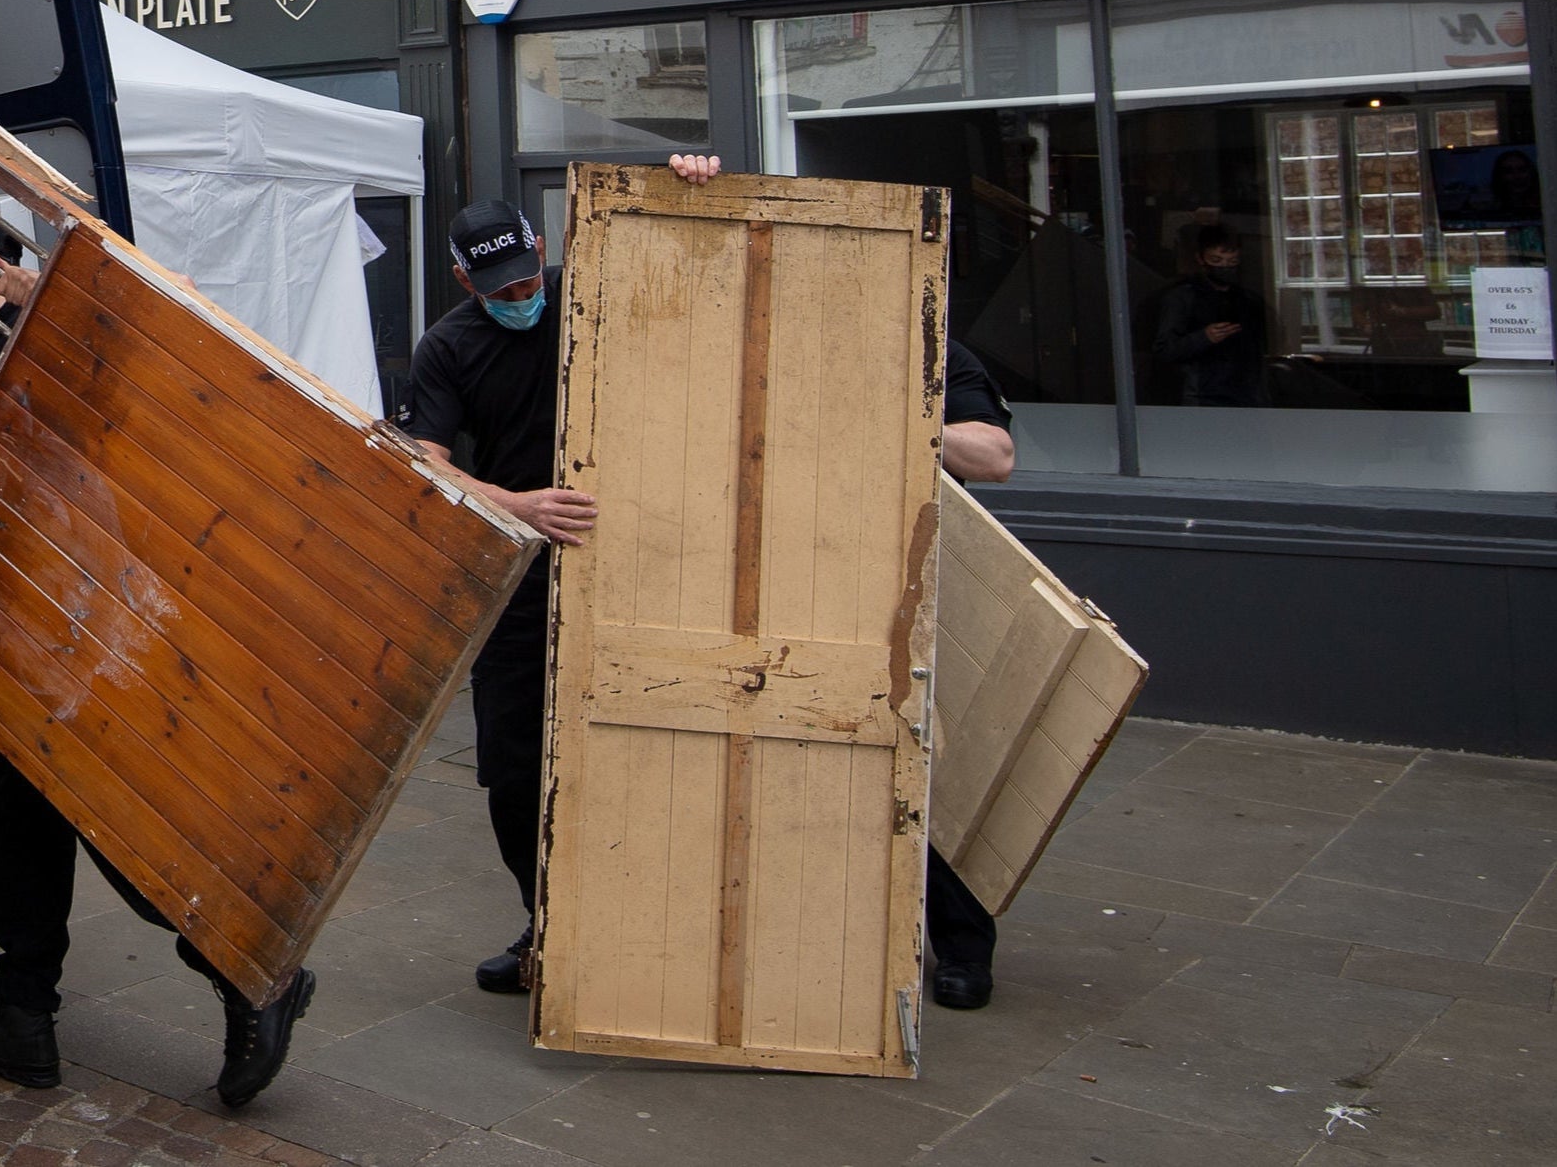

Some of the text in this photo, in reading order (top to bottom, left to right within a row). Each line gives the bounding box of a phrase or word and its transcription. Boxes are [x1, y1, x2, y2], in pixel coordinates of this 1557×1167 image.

[470, 232, 517, 259] POLICE
[1488, 286, 1512, 294] OVER
[1489, 326, 1538, 334] THURSDAY
